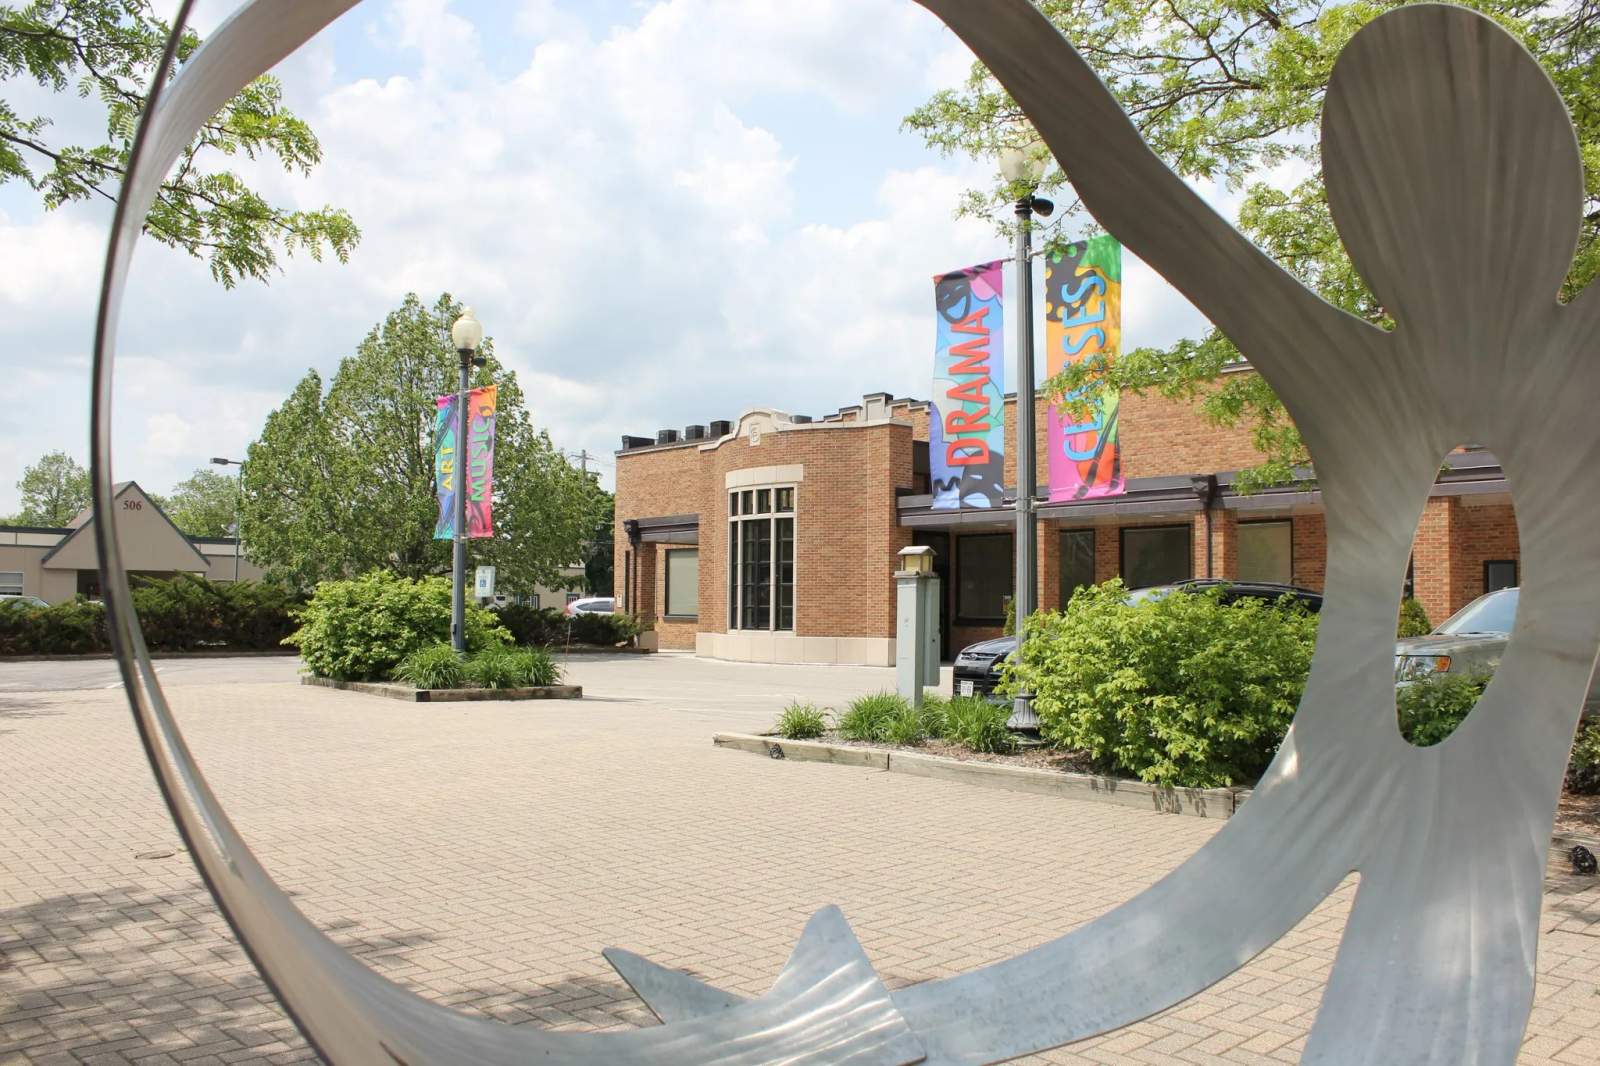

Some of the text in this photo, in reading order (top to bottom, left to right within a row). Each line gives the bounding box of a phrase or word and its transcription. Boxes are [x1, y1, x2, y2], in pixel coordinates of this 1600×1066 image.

[945, 307, 990, 467] DRAMA
[440, 447, 454, 491] ART
[471, 416, 491, 502] MUSIC
[123, 500, 142, 511] 506
